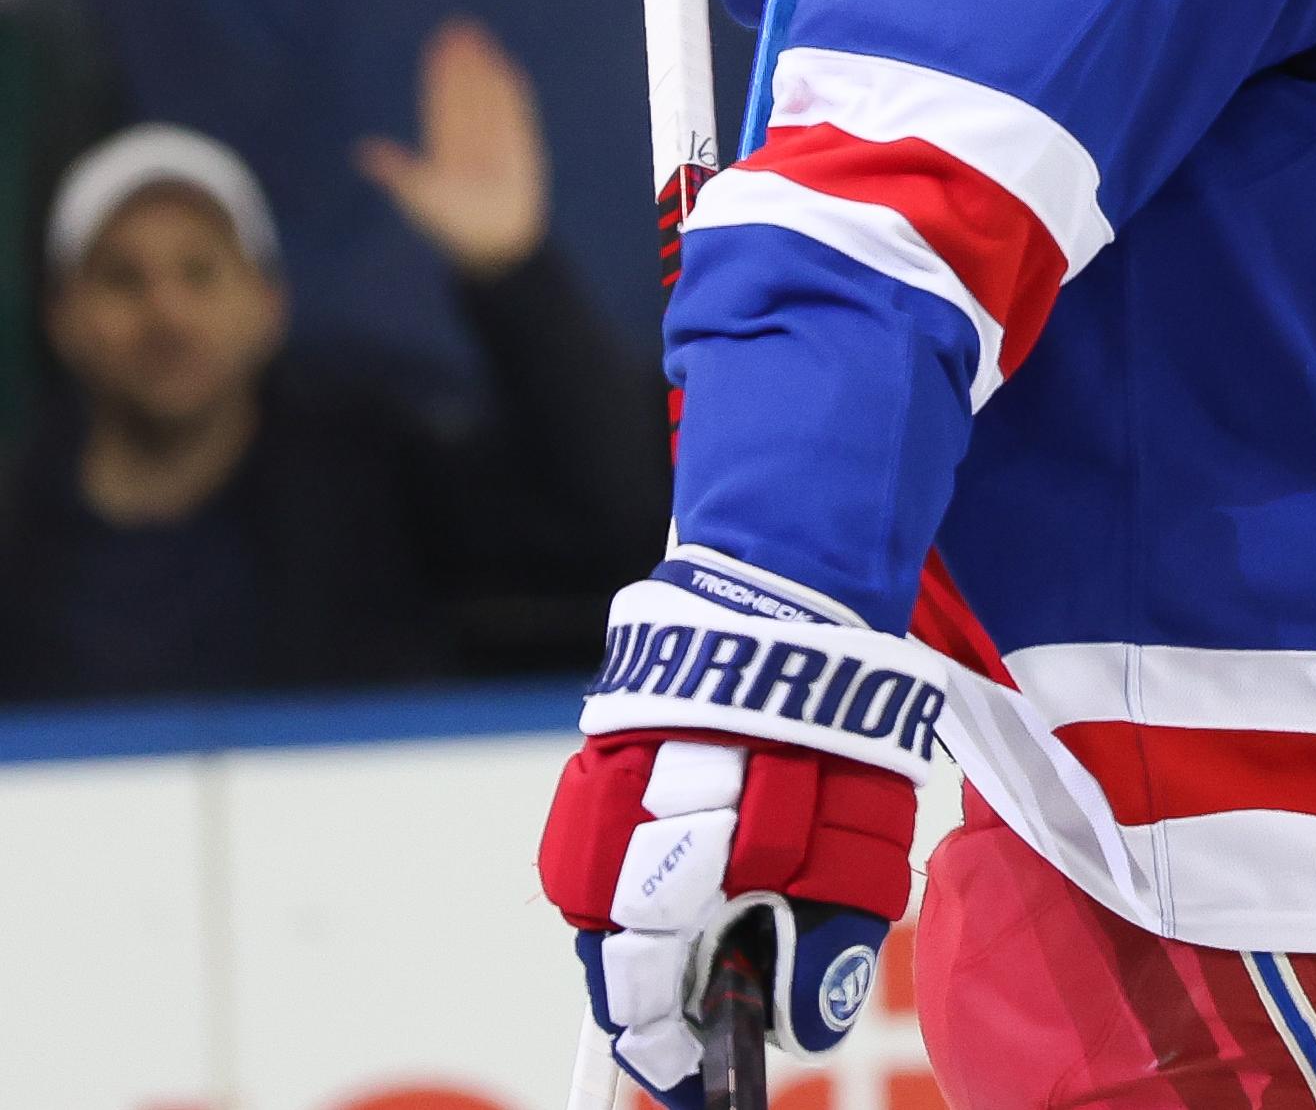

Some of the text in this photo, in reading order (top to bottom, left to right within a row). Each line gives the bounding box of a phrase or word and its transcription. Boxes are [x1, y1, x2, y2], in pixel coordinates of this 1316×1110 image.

[688, 130, 717, 167] 16
[588, 623, 945, 762] WARRIOR
[640, 830, 695, 898] OVERT
